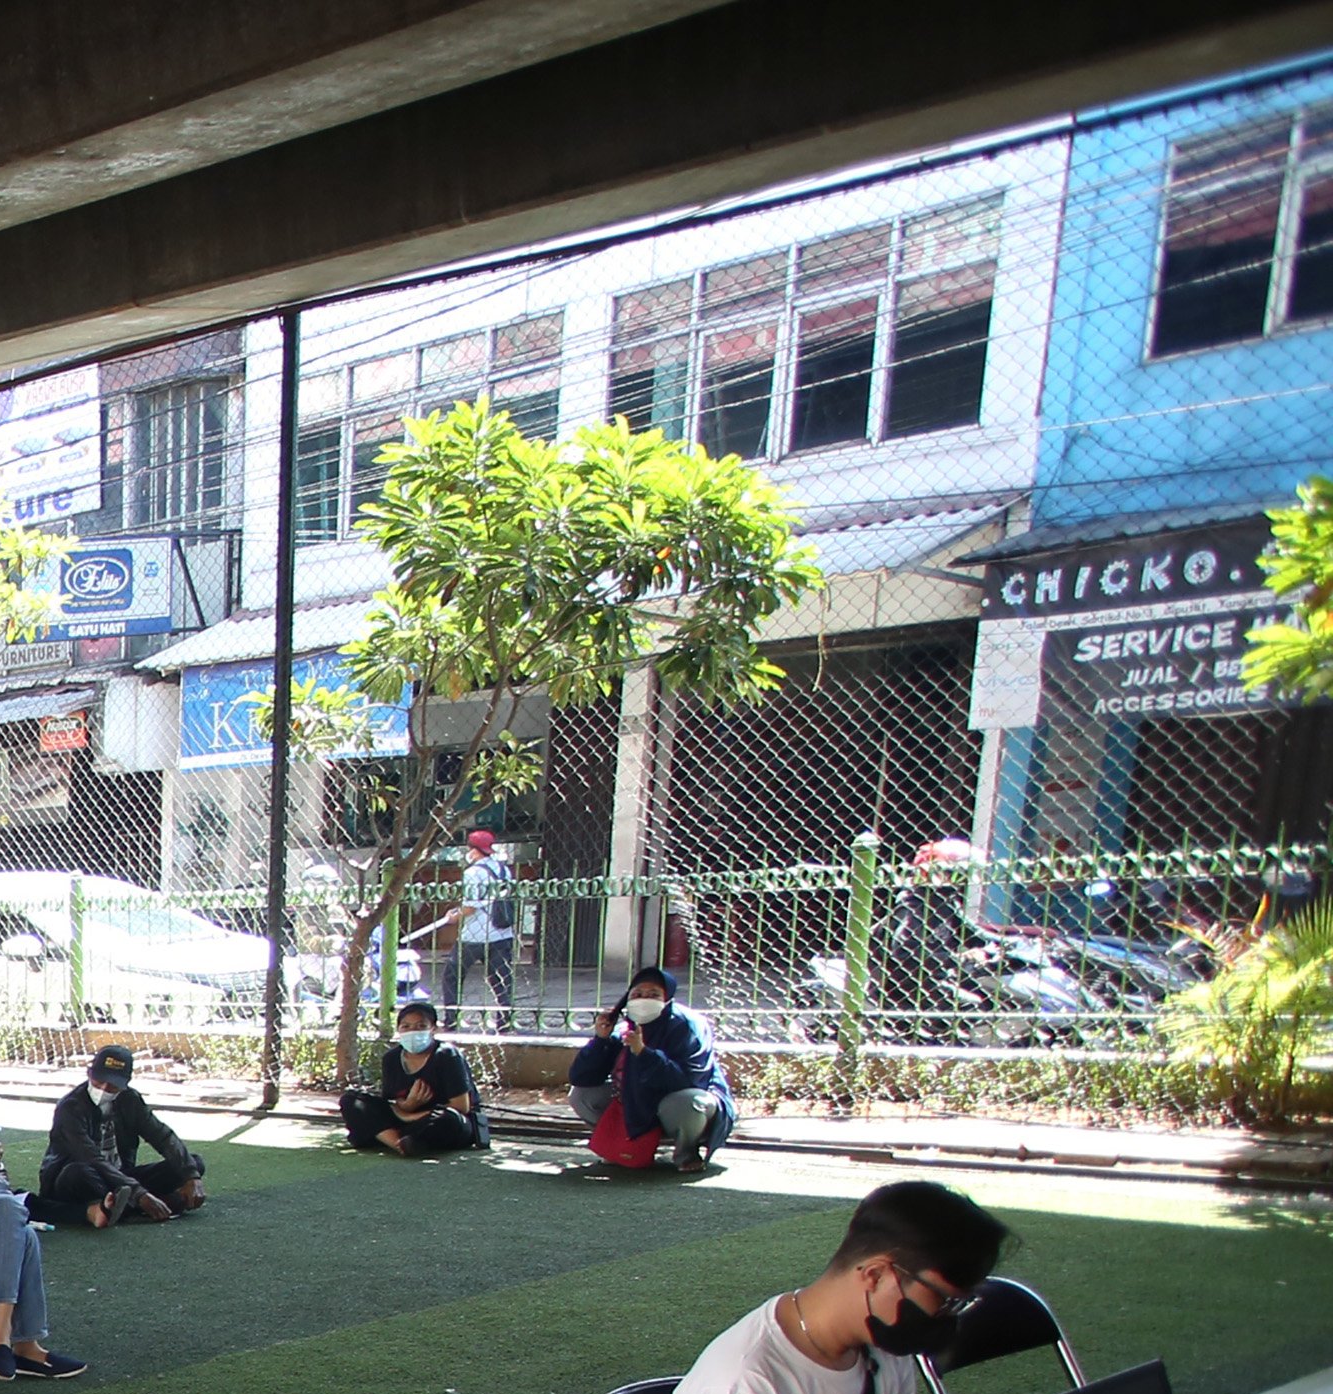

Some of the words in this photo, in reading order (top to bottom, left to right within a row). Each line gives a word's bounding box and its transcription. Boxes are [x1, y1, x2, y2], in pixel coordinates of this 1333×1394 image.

[68, 623, 98, 637] SATU
[100, 622, 126, 635] HATI
[1073, 619, 1237, 663] SERVICE
[1121, 665, 1179, 688] JUAL
[1093, 684, 1269, 715] ACCESSORIES
